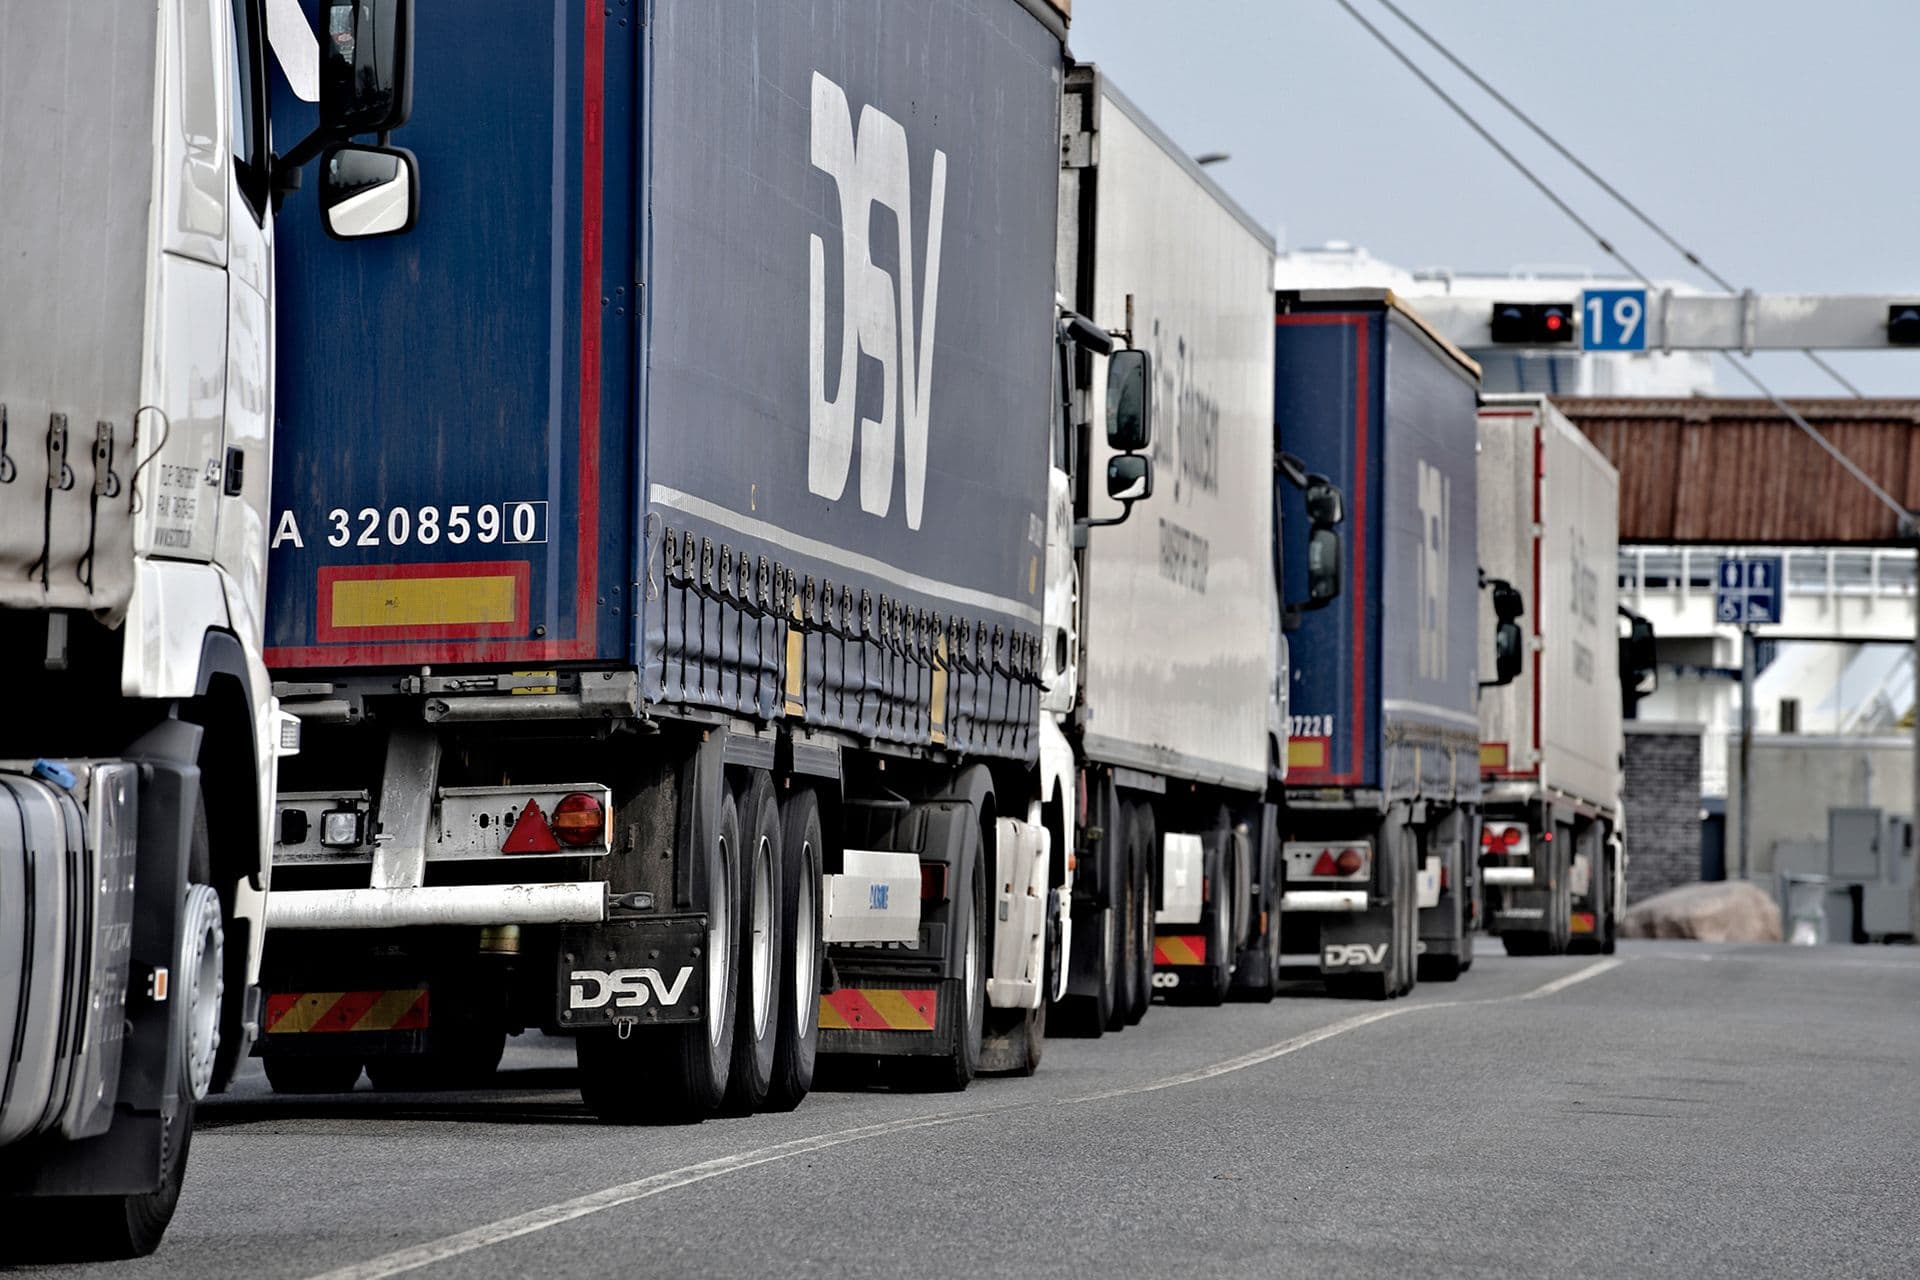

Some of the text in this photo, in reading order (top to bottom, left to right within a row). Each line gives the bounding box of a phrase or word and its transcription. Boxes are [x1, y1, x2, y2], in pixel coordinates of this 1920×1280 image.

[808, 70, 947, 530] DSV
[1586, 296, 1642, 345] 19
[271, 510, 304, 548] A
[1325, 943, 1389, 967] DSV
[570, 966, 694, 1009] DSV
